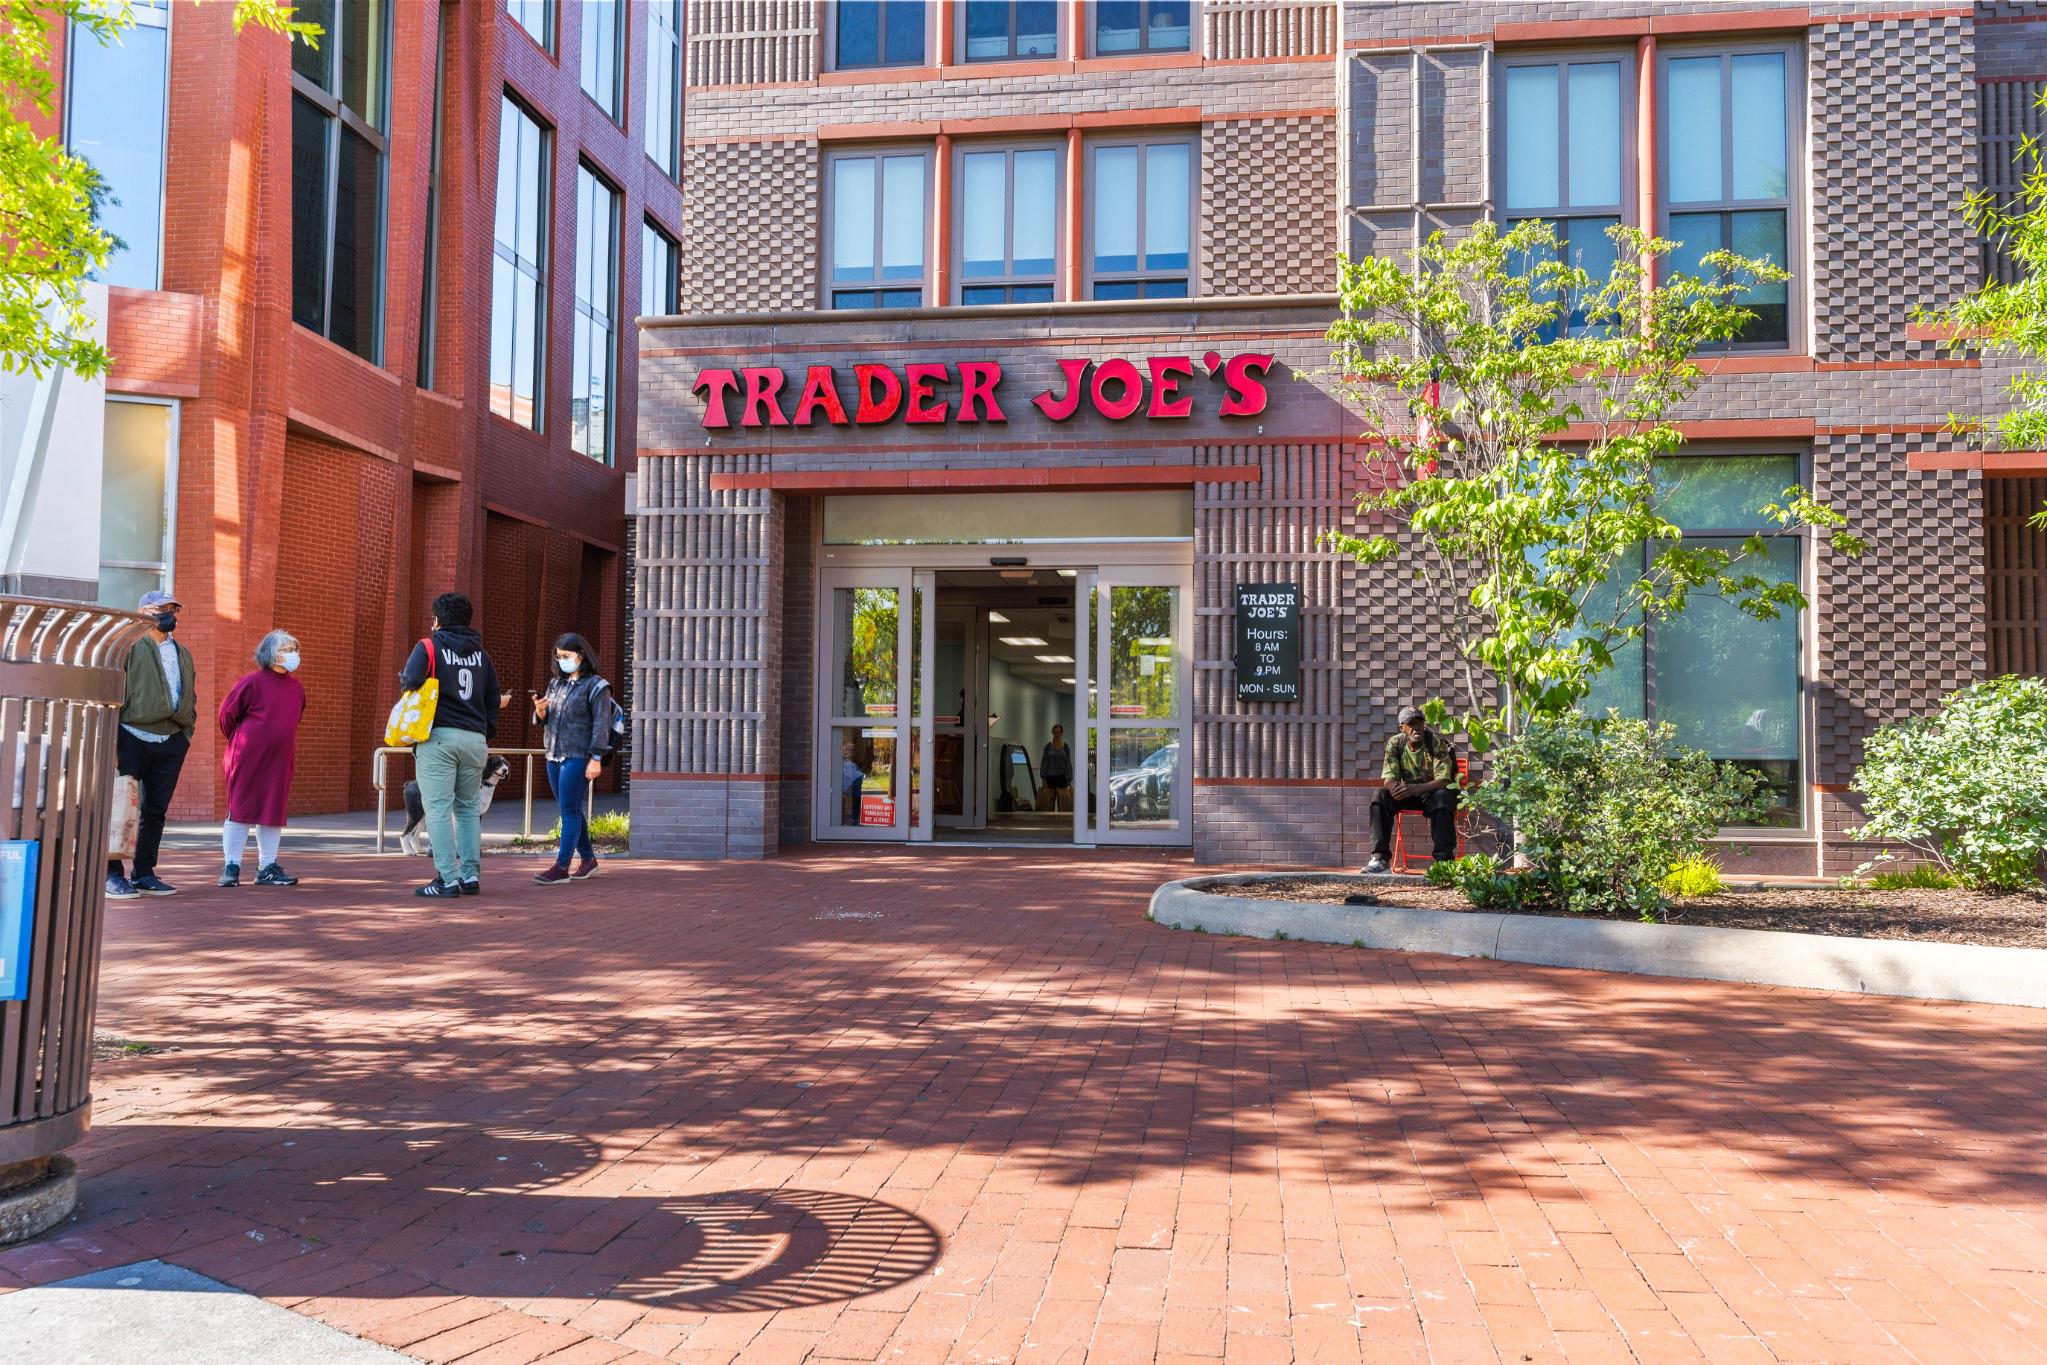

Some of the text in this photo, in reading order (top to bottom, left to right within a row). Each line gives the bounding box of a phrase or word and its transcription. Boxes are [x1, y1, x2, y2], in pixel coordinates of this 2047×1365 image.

[692, 351, 1277, 429] TRADER JOE'S
[1240, 593, 1295, 606] TRADER
[1247, 606, 1288, 618] JOE'S
[1247, 628, 1288, 640] Hours:
[1255, 642, 1280, 652] 8 AM
[1259, 654, 1275, 663] TO
[1256, 666, 1281, 676] 9 PM
[458, 668, 473, 700] 9
[1239, 684, 1264, 693] MON
[1273, 684, 1295, 693] SUN
